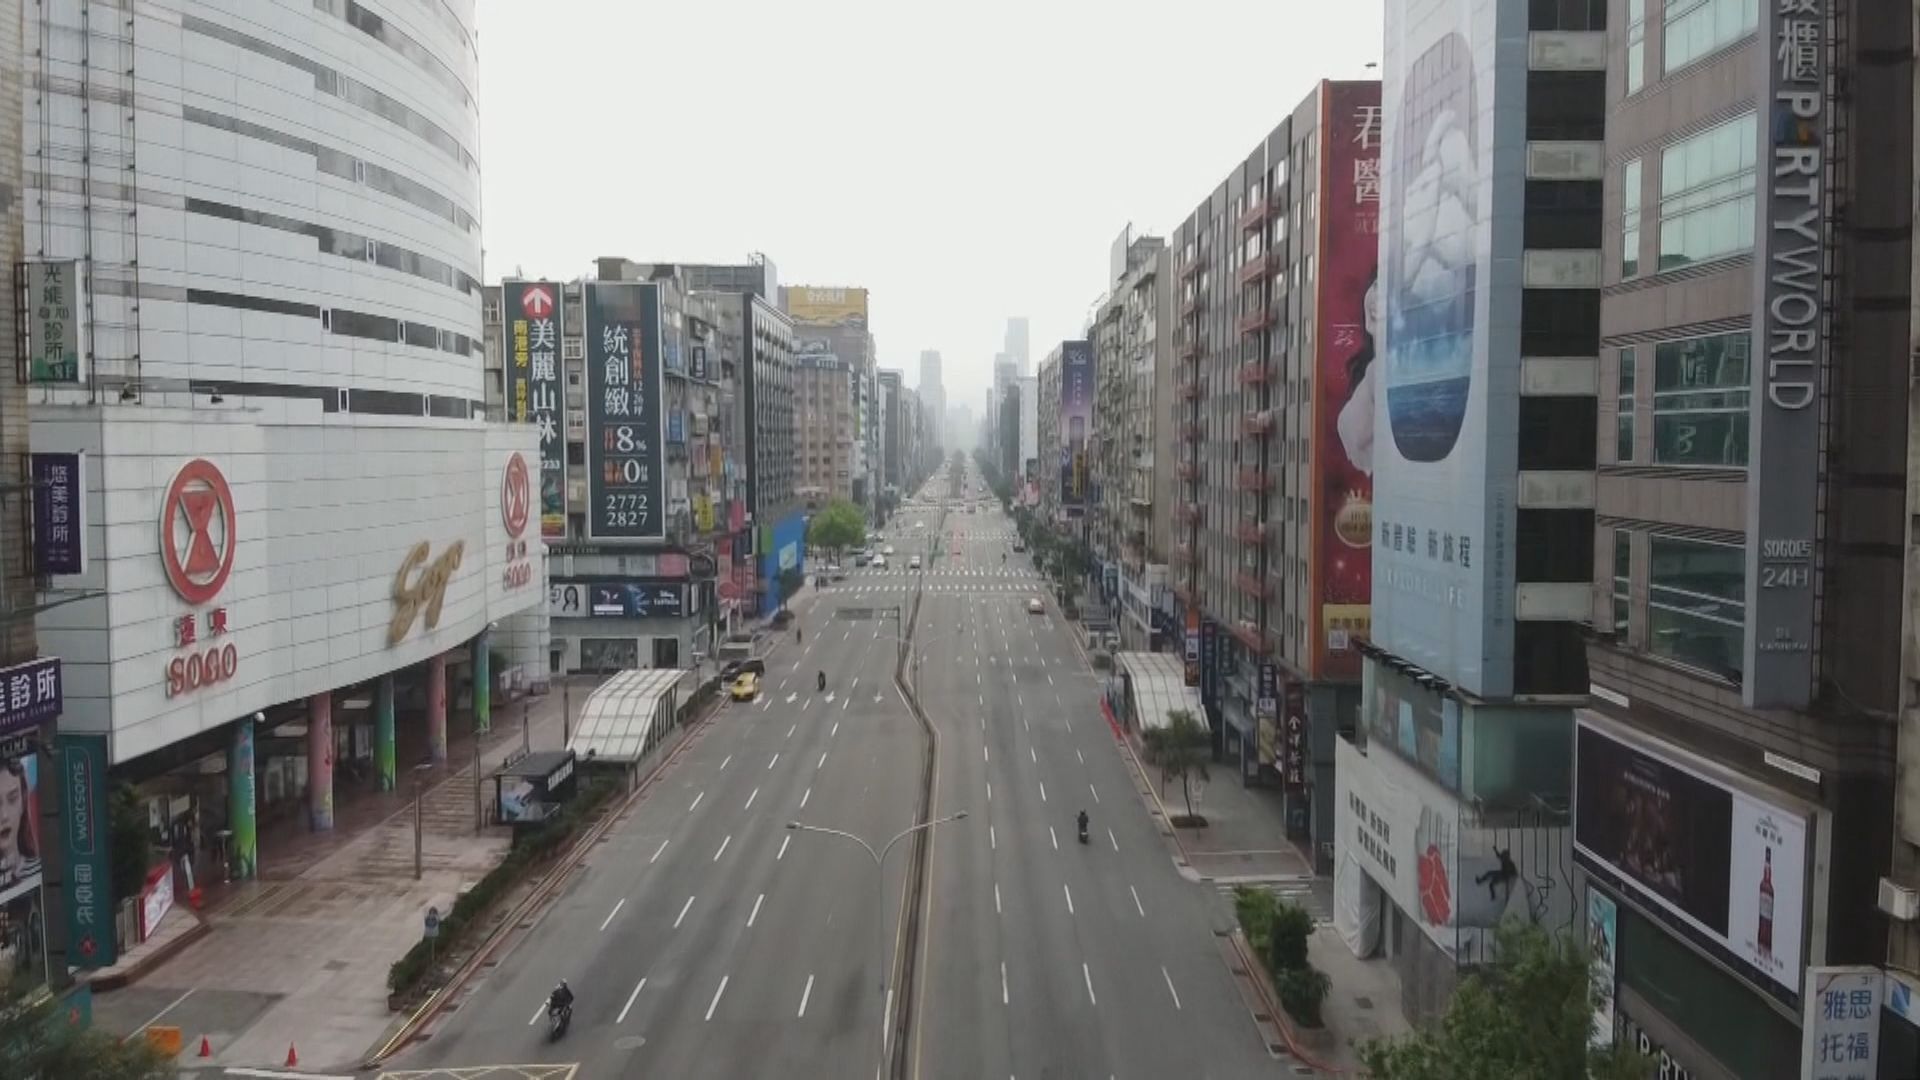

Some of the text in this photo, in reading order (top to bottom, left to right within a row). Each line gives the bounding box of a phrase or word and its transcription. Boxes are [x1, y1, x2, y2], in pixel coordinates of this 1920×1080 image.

[1777, 0, 1819, 82] 櫃
[531, 319, 557, 444] 美麗山林
[606, 494, 648, 510] 2772
[607, 511, 648, 526] 2827
[1762, 568, 1808, 588] 24H
[0, 666, 56, 713] 診所
[168, 643, 238, 697] SOGO
[73, 760, 88, 842] watsons
[1823, 990, 1872, 1020] 雅思
[1820, 1031, 1869, 1064] 托福
